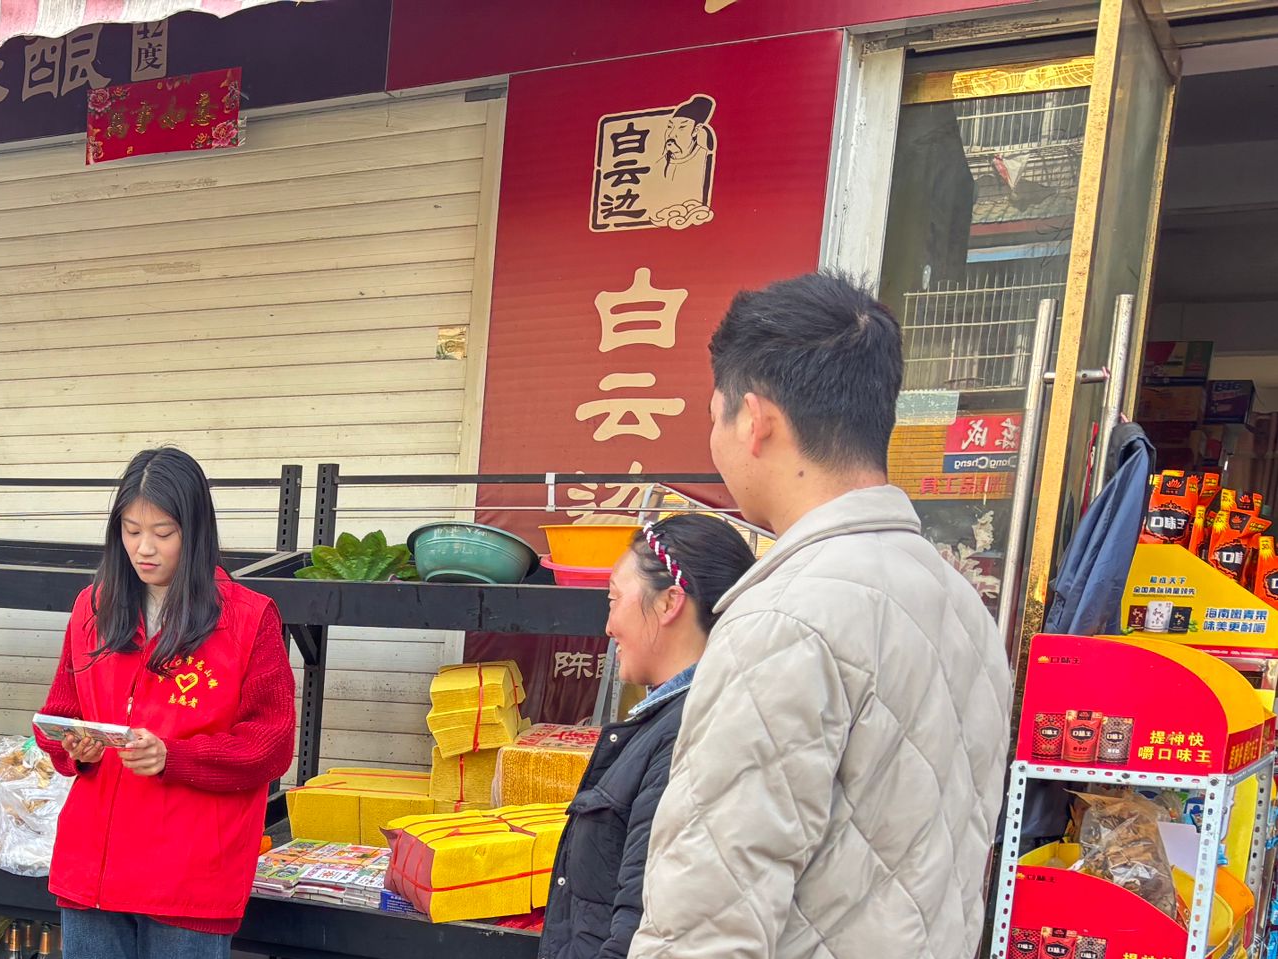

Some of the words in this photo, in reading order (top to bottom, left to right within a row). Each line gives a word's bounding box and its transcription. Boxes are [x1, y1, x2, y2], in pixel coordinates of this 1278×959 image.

[600, 121, 650, 220] 白云边
[566, 267, 689, 526] 白云边
[1150, 516, 1186, 530] 口味王
[1150, 730, 1204, 746] 提神快
[1138, 746, 1212, 764] 嚼口味王
